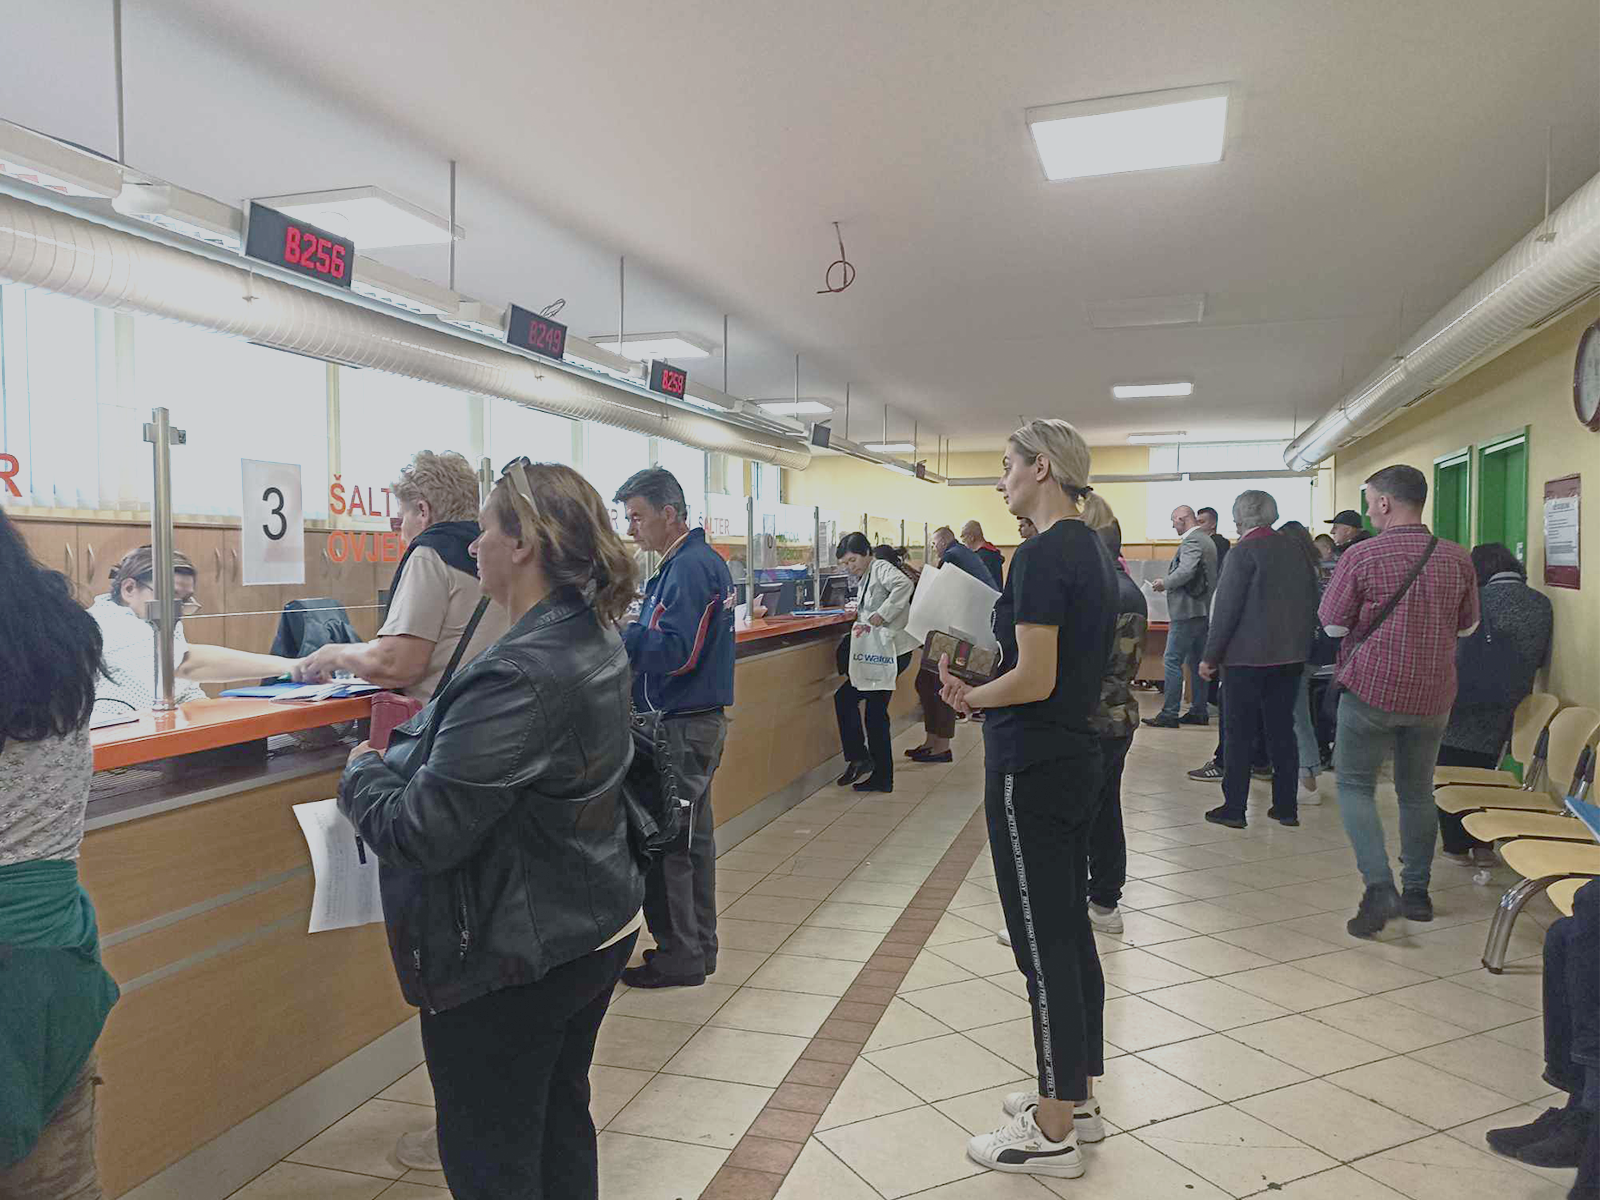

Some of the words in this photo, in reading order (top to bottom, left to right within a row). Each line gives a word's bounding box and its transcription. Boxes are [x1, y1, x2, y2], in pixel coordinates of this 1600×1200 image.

[284, 226, 346, 278] B256
[529, 320, 562, 354] B249
[262, 487, 288, 540] 3
